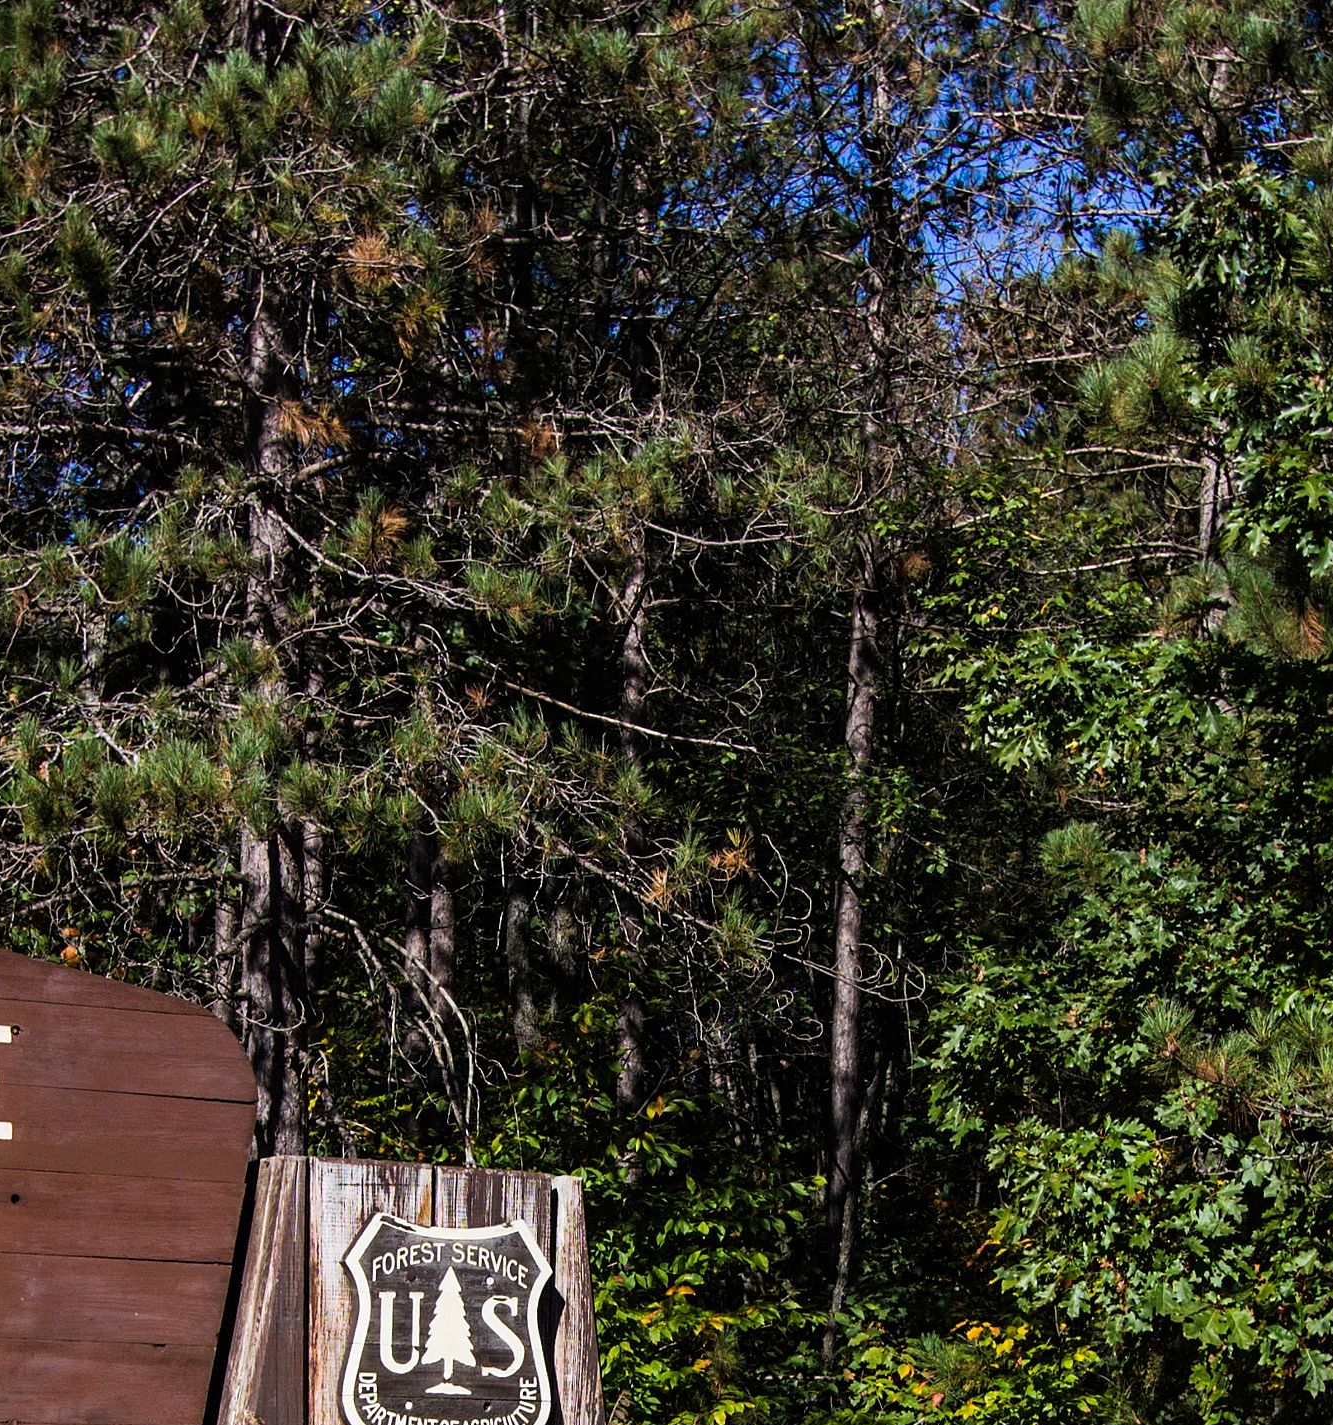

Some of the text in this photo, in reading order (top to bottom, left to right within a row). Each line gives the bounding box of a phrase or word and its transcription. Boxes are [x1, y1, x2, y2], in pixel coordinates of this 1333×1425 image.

[372, 1242, 529, 1289] FOREST SERVICE
[378, 1291, 525, 1378] U S
